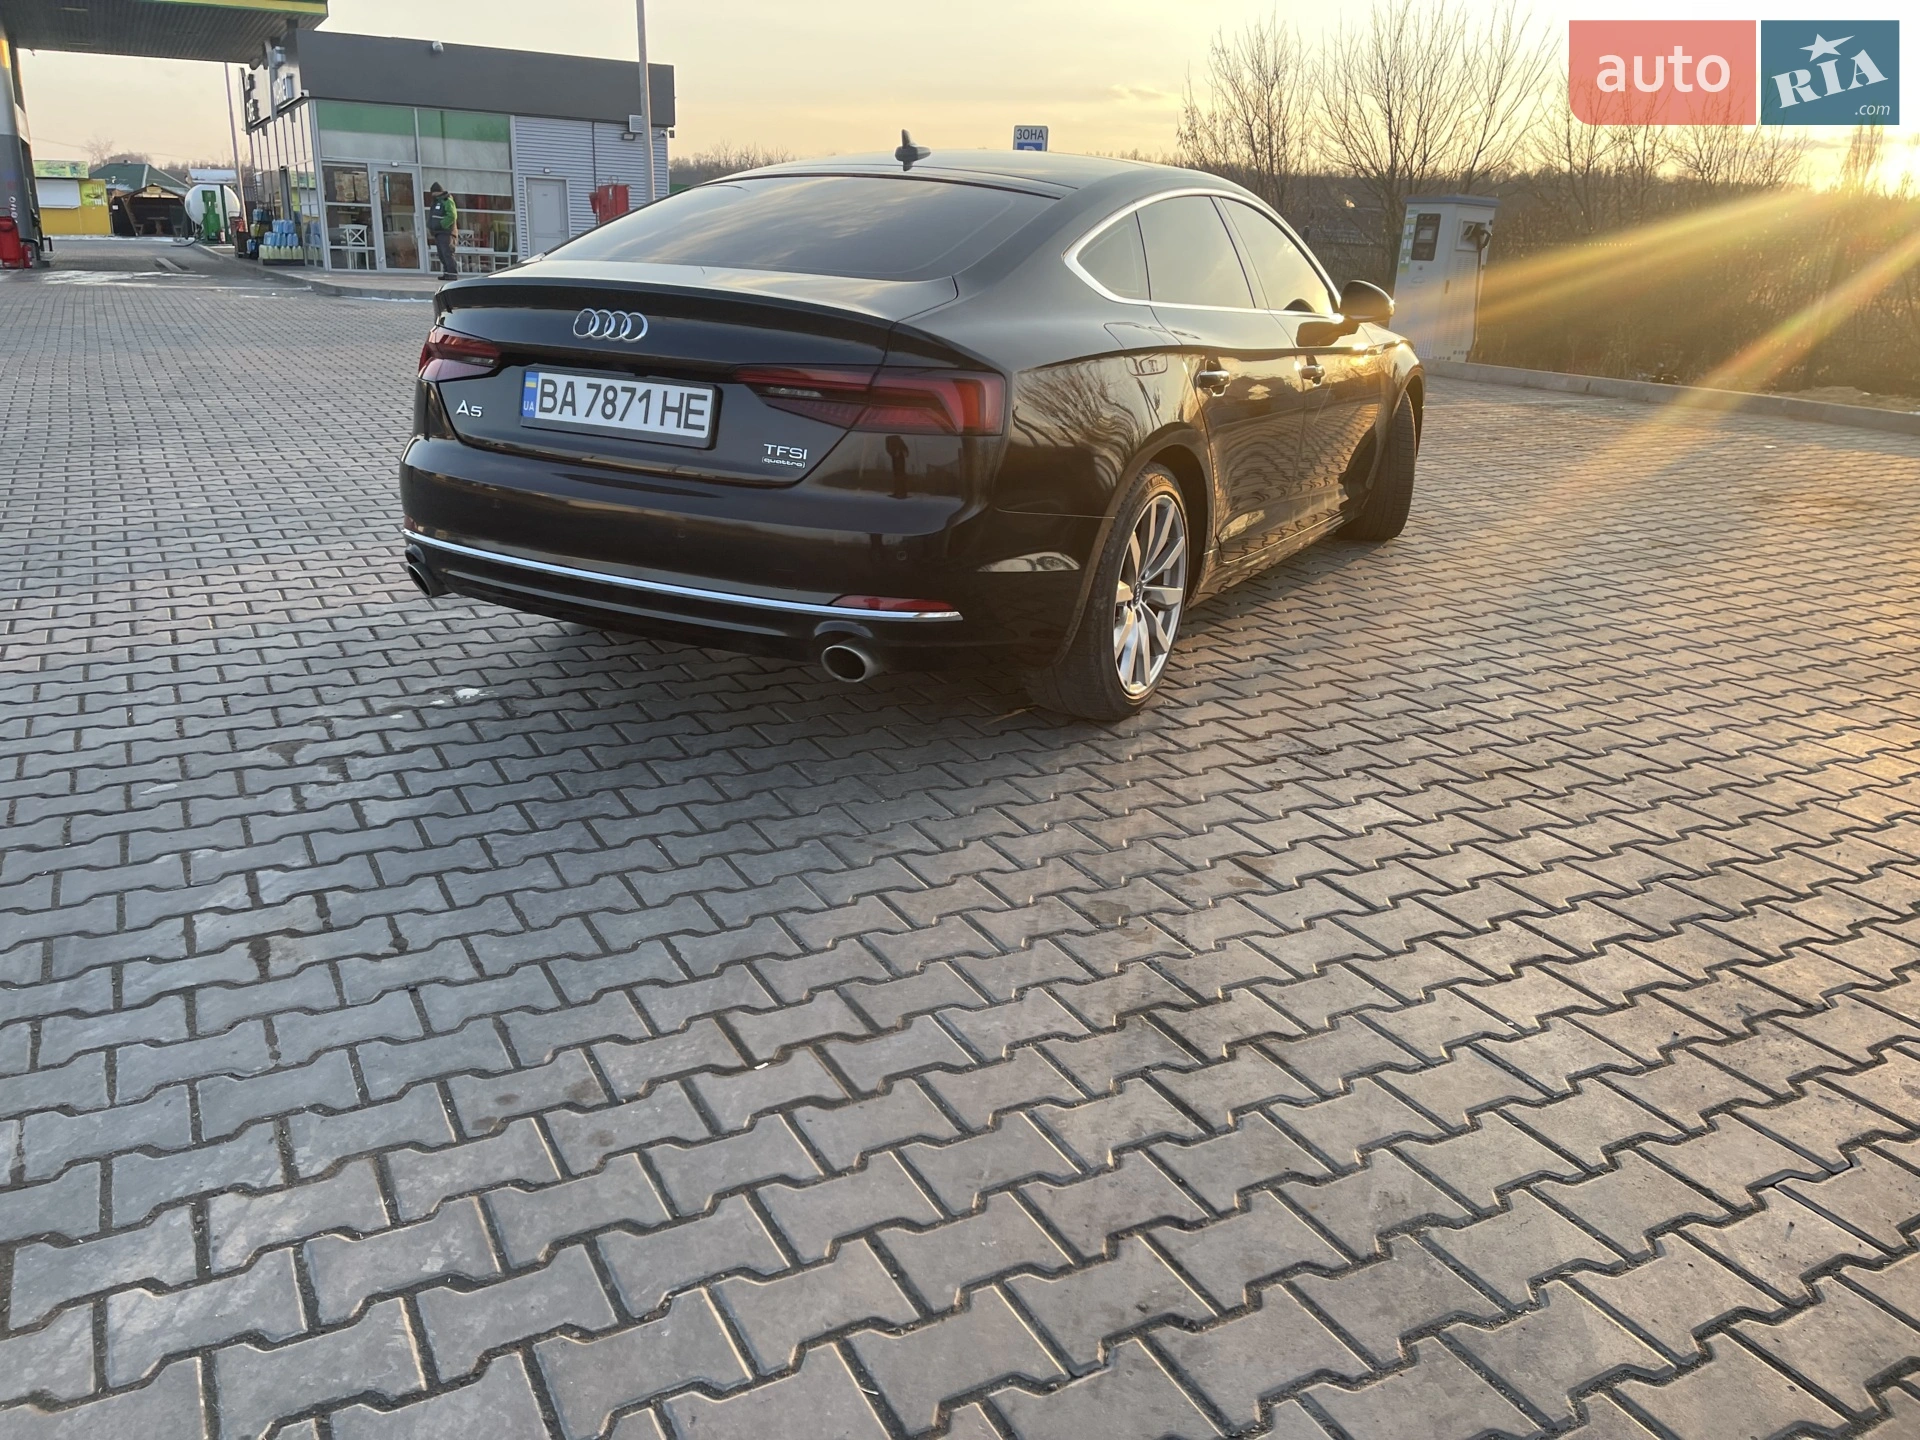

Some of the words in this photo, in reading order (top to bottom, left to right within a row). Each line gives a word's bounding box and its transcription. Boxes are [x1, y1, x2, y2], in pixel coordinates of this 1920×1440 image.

[1016, 128, 1044, 141] ЗОНА
[456, 399, 483, 418] A5
[523, 400, 535, 412] UA
[538, 378, 577, 417] BA
[584, 382, 652, 425] 7871
[659, 390, 708, 432] HE
[763, 443, 808, 460] TFSI
